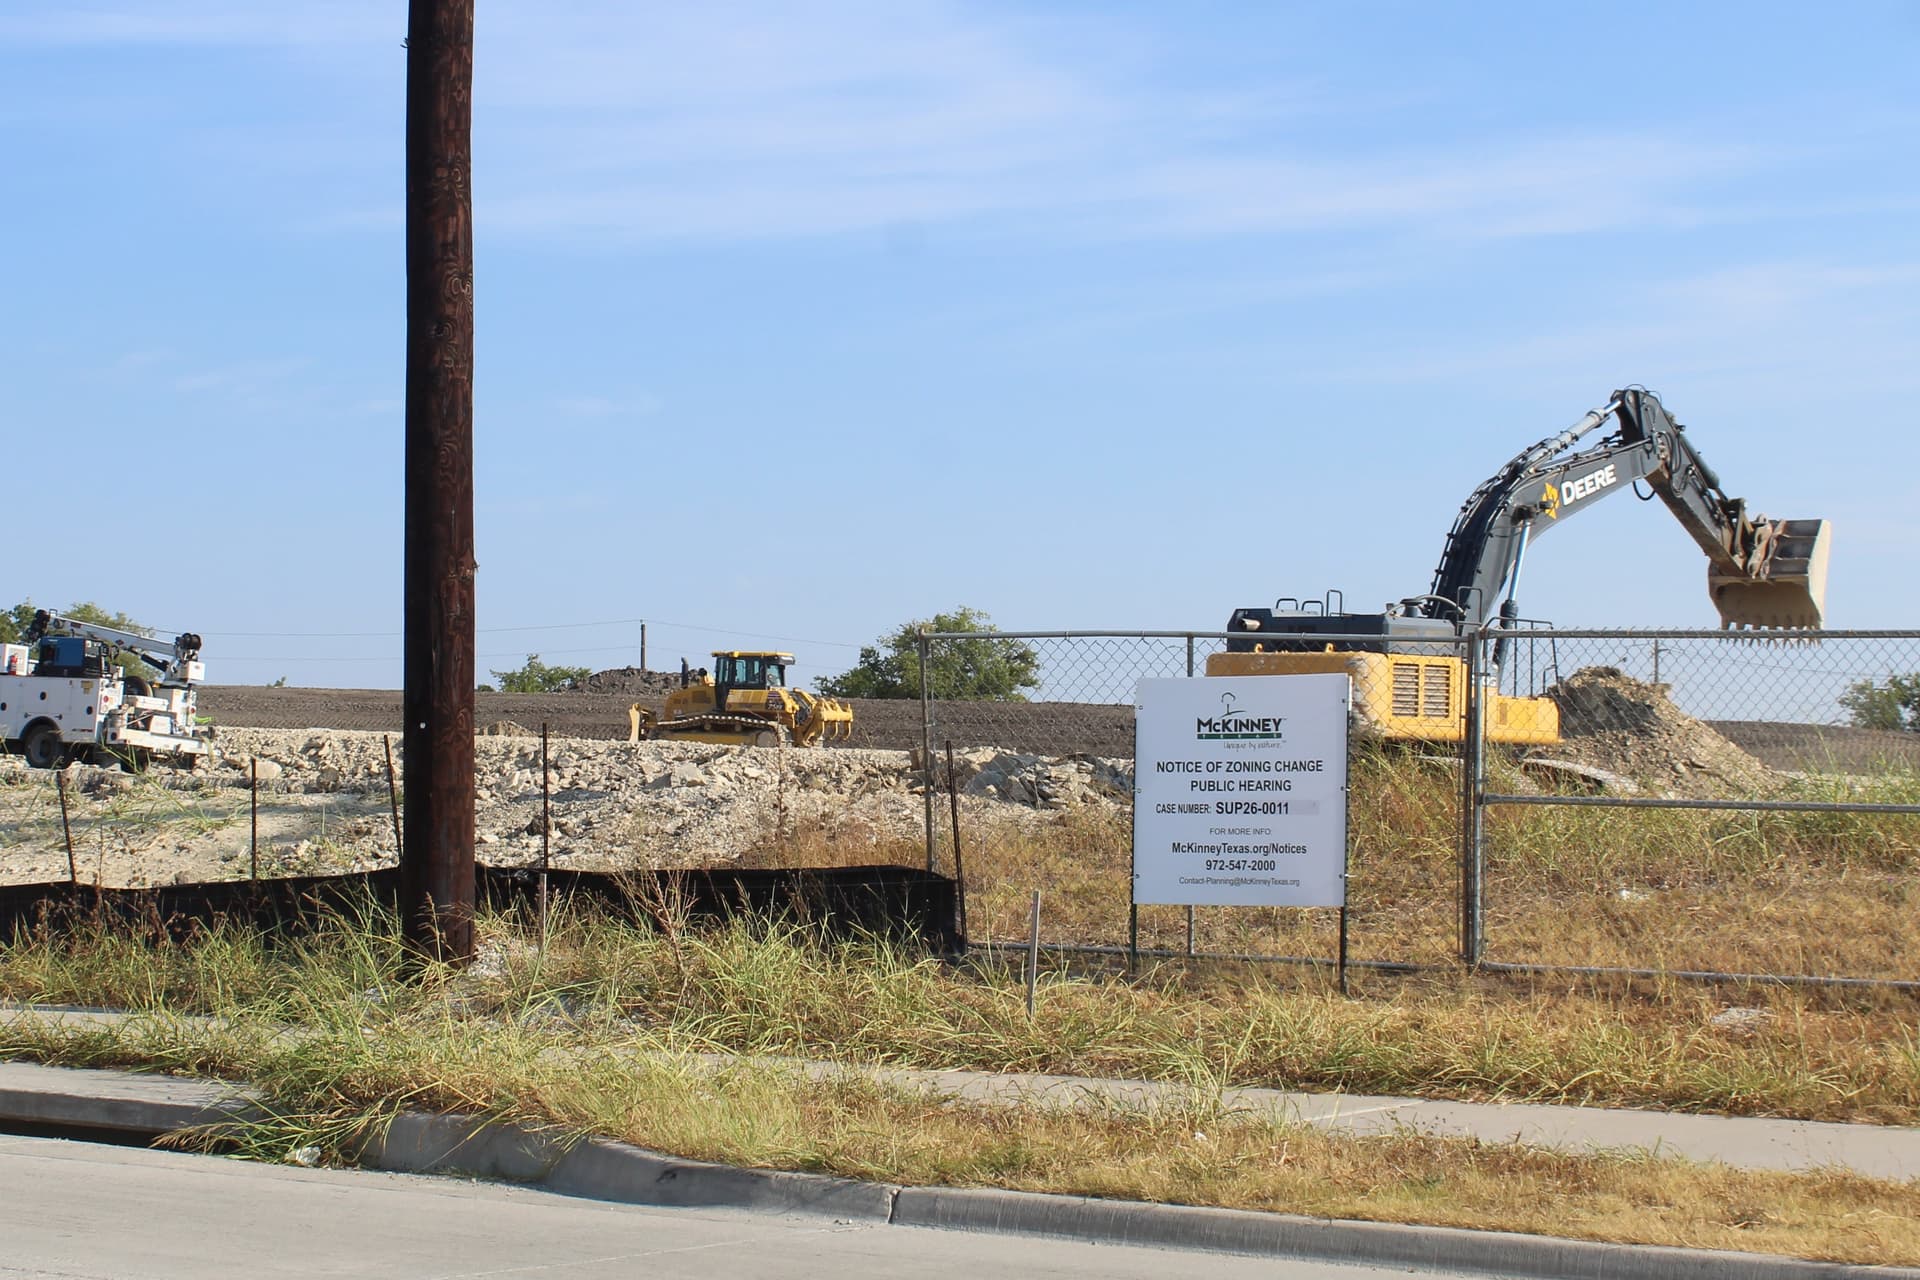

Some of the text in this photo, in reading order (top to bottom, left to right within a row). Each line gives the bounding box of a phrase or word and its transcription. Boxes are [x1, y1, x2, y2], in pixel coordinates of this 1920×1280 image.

[1561, 464, 1617, 506] DEERE
[1197, 718, 1282, 732] McKINNEY
[1156, 760, 1324, 773] NOTICE OF ZONING CHANGE
[1190, 780, 1292, 792] PUBLIC HEARING
[1156, 801, 1289, 815] CASE NUMBER: SUP26-0011
[1209, 828, 1226, 836] FOR
[1228, 828, 1251, 836] MORE
[1172, 842, 1307, 856] McKinneyTexas.org/Notices
[1205, 859, 1276, 871] 972-547-2000
